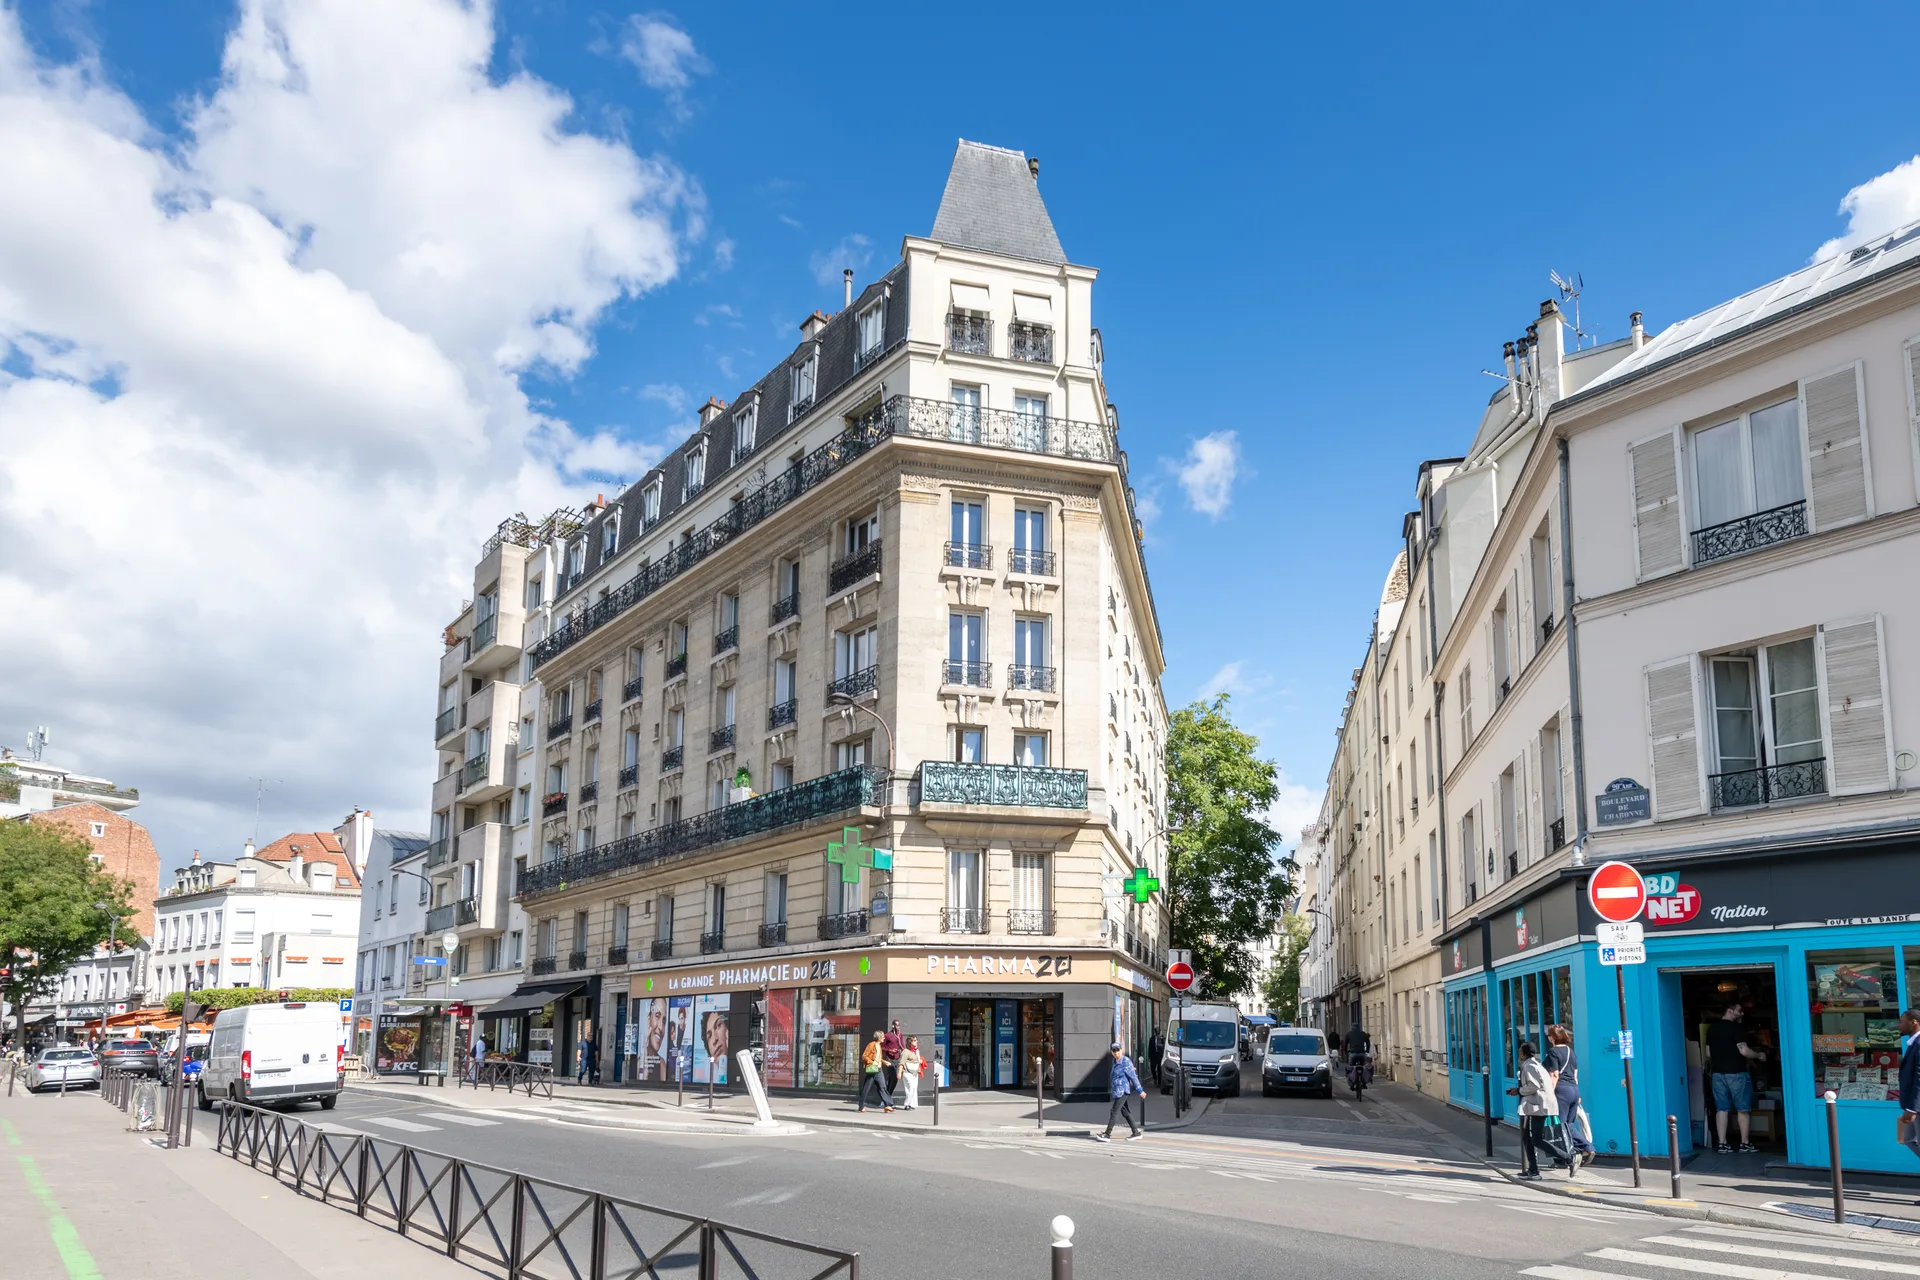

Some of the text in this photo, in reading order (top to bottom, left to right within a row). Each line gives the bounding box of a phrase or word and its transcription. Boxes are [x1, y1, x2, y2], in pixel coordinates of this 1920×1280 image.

[1601, 794, 1645, 806] BOULEVARD
[1604, 809, 1644, 820] CHARONNE
[1645, 875, 1676, 895] BD
[1647, 891, 1696, 920] NET
[1710, 904, 1769, 922] Nation
[1879, 914, 1911, 923] BANDE
[668, 978, 679, 990] LA
[681, 975, 714, 988] GRANDE
[719, 964, 790, 986] PHARMACIE
[793, 966, 808, 980] DU
[342, 1002, 349, 1010] P
[391, 1061, 418, 1071] KFC
